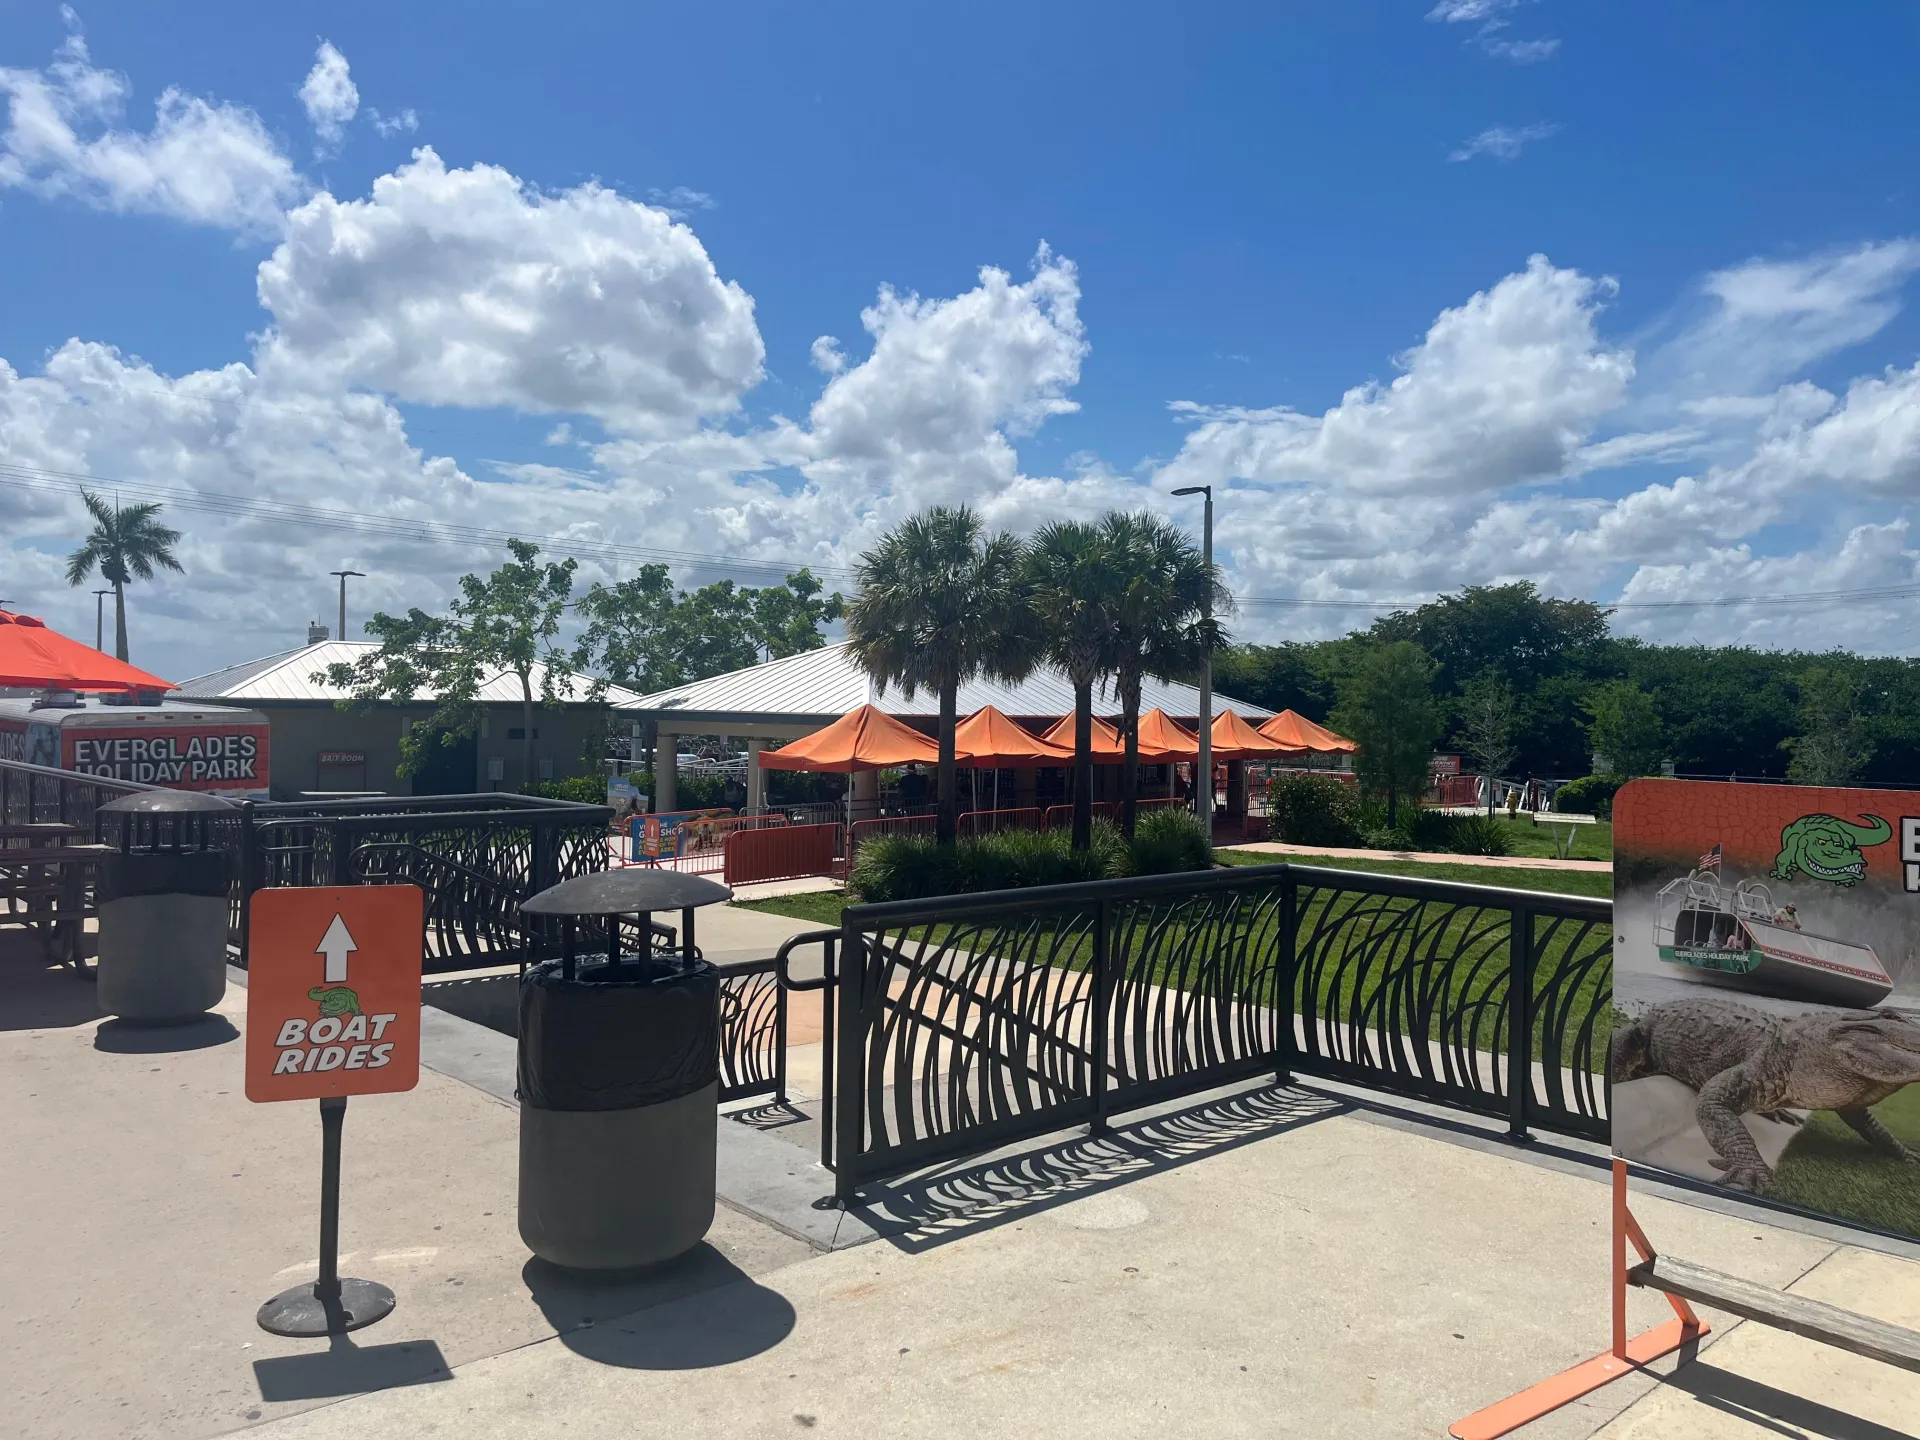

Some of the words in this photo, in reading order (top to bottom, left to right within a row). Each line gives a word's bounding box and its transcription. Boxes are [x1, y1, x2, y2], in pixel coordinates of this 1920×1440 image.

[75, 736, 256, 763] EVERGLADES
[321, 754, 339, 762] BAIT
[340, 754, 364, 762] ROOM
[191, 758, 256, 780] PARK
[1675, 950, 1708, 959] EVERGLADES
[1708, 952, 1731, 960] HOLIDAY
[1732, 954, 1750, 962] PARK
[274, 1013, 397, 1046] BOAT
[272, 1043, 395, 1075] RIDES
